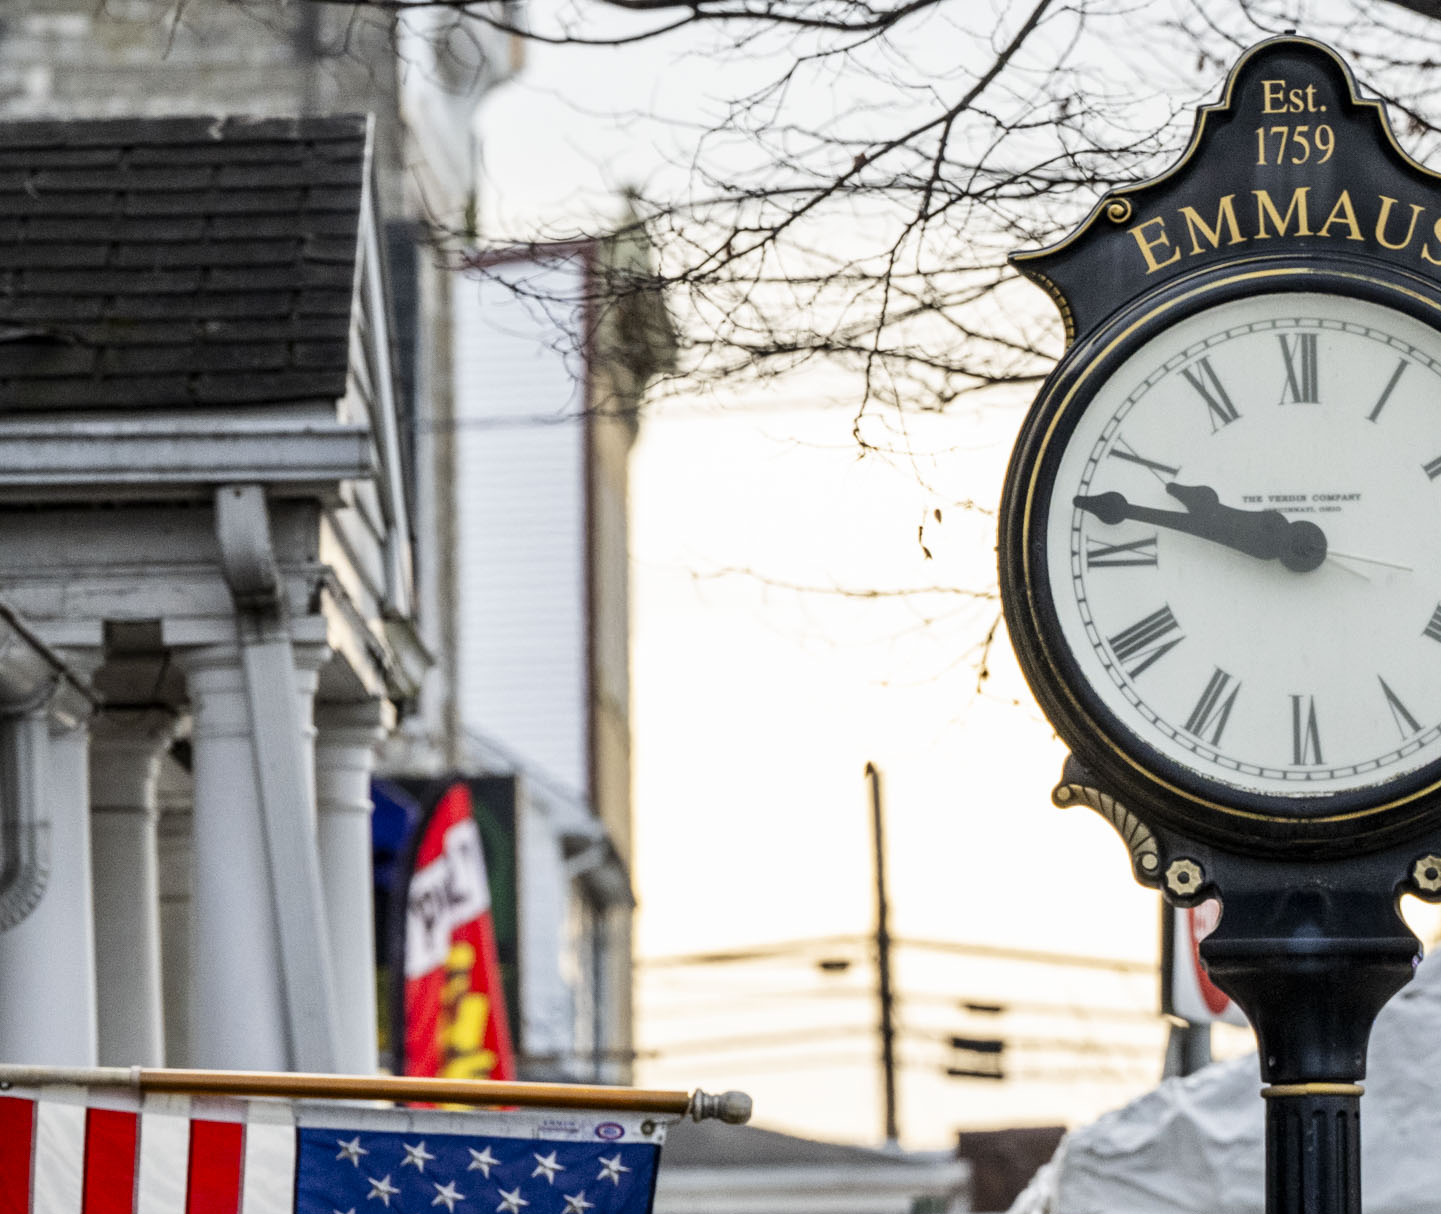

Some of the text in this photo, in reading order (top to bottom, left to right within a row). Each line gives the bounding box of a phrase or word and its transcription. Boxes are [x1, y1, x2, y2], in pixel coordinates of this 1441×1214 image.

[1260, 79, 1327, 115] Est.
[1255, 124, 1336, 166] 1759
[1177, 355, 1244, 435] XI
[1278, 332, 1321, 405] XII
[1366, 358, 1411, 423] I
[1242, 493, 1361, 503] THE VERDIN COMPANY
[1106, 602, 1187, 683] VIII
[1182, 665, 1243, 749] VII
[1288, 694, 1325, 766] VI
[1377, 673, 1426, 740] V
